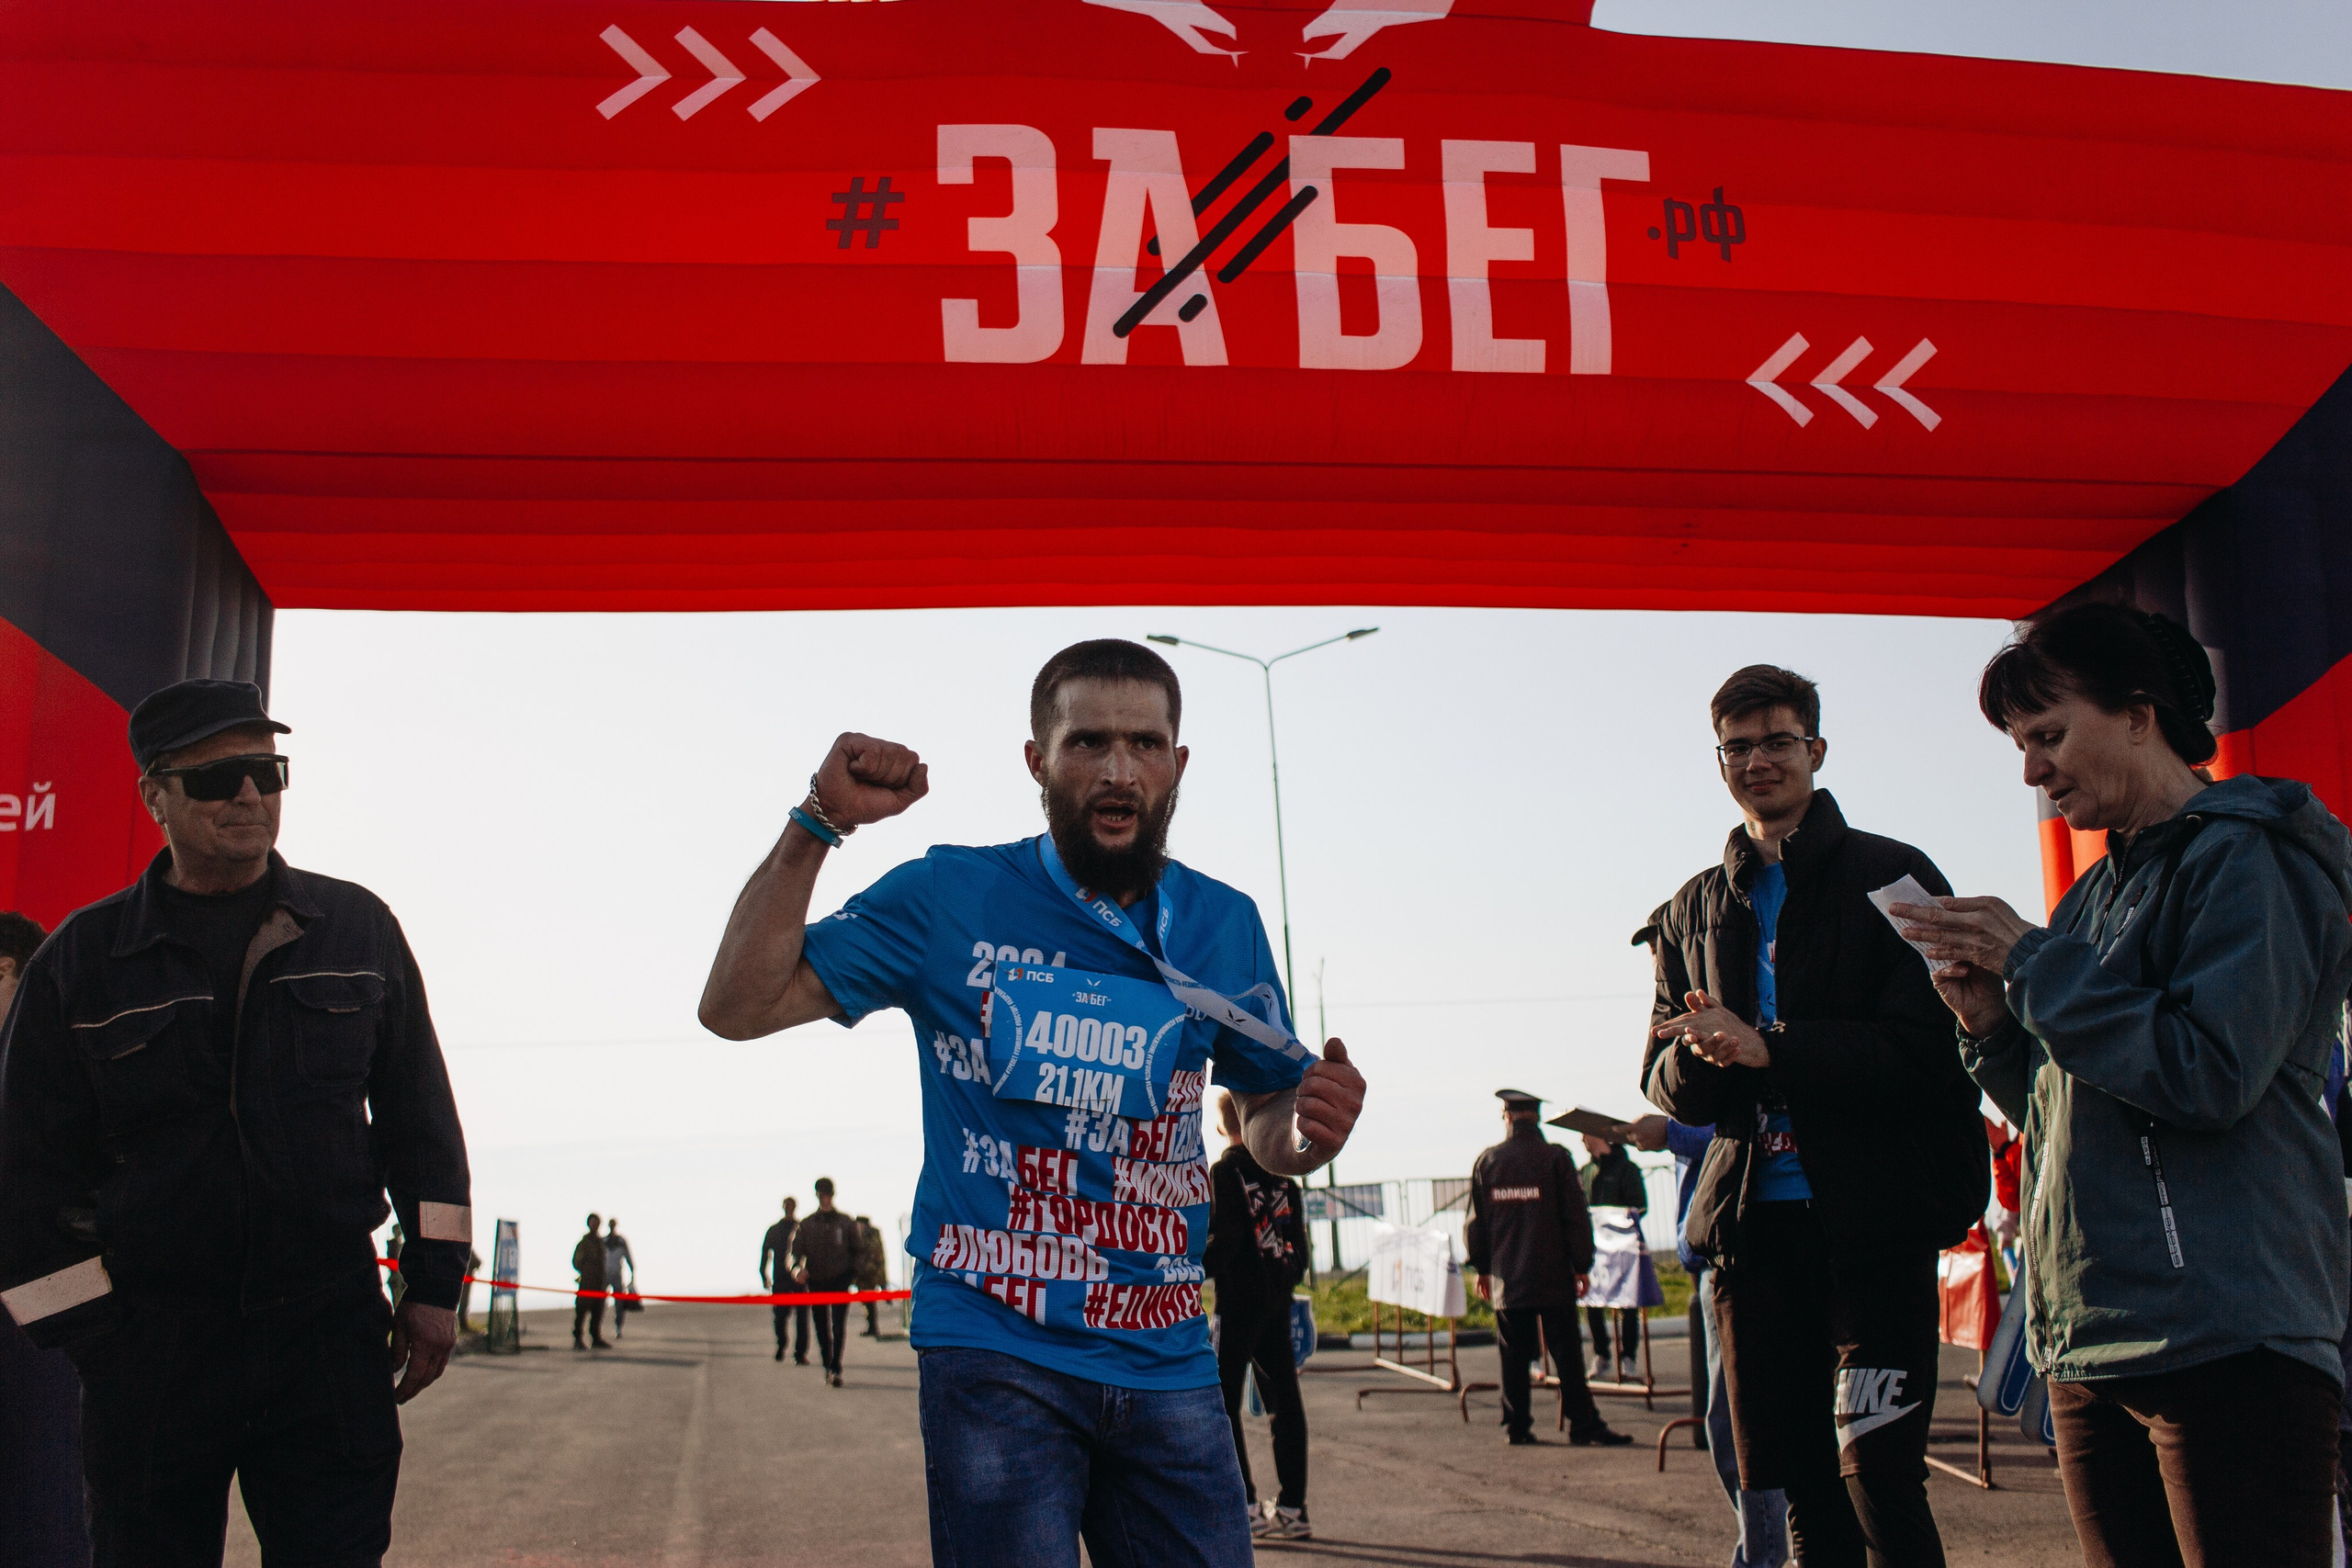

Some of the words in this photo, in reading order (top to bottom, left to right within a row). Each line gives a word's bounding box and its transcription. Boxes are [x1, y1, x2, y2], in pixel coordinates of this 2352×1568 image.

[1092, 900, 1122, 927] ПСБ
[1159, 907, 1170, 939] ПСБ
[1026, 970, 1055, 983] ПСБ
[1025, 1010, 1148, 1070] 40003
[1493, 1186, 1541, 1200] ПОЛИЦИЯ
[1009, 1182, 1188, 1255] #ГОРДОСТЬ
[932, 1224, 1109, 1280] #ЛЮБОВЬ
[1834, 1368, 1907, 1415] NIKE
